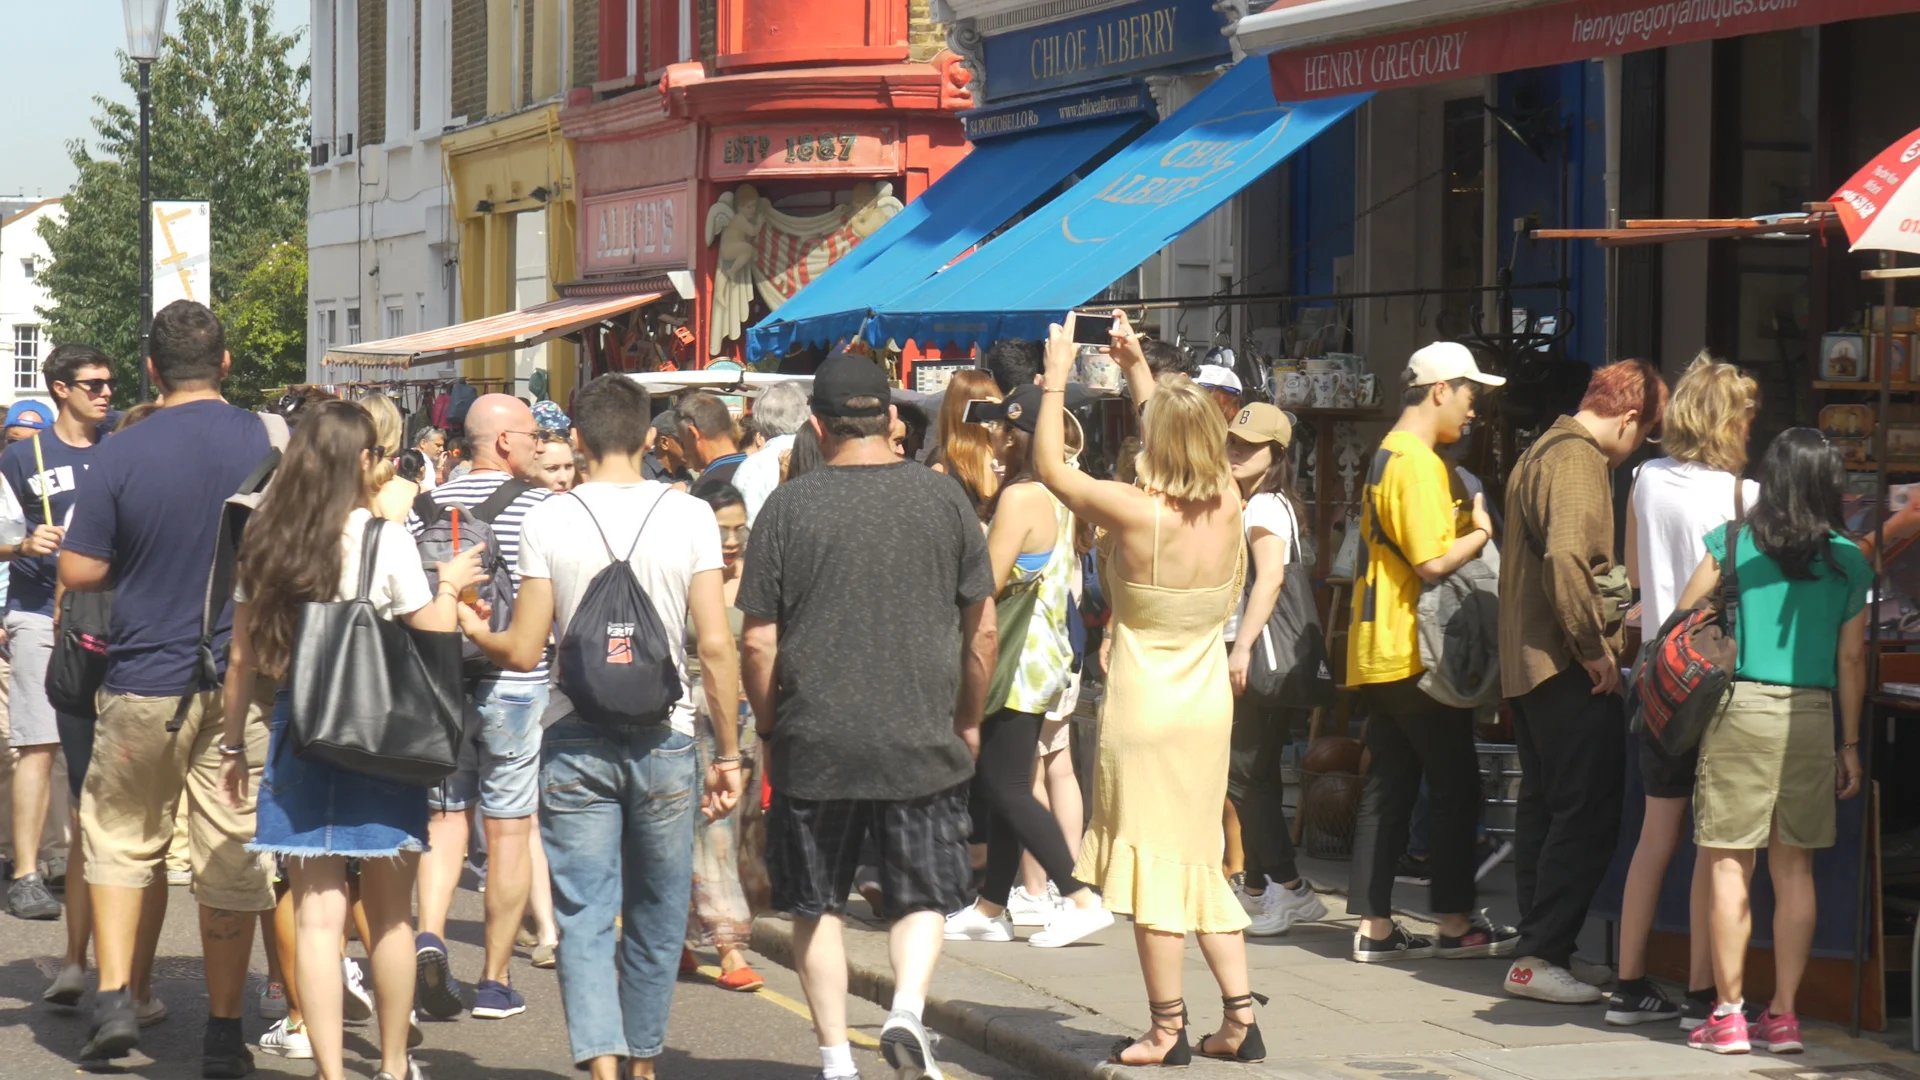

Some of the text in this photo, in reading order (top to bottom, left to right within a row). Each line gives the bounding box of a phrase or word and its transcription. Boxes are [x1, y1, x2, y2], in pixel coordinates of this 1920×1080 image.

[1030, 6, 1178, 80] CHLOE ALBERRY
[1304, 31, 1468, 92] HENRY GREGORY
[977, 110, 1027, 135] PORTOBELLO
[784, 132, 857, 164] 1887
[597, 197, 676, 258] ALICE'S
[1239, 410, 1250, 425] B
